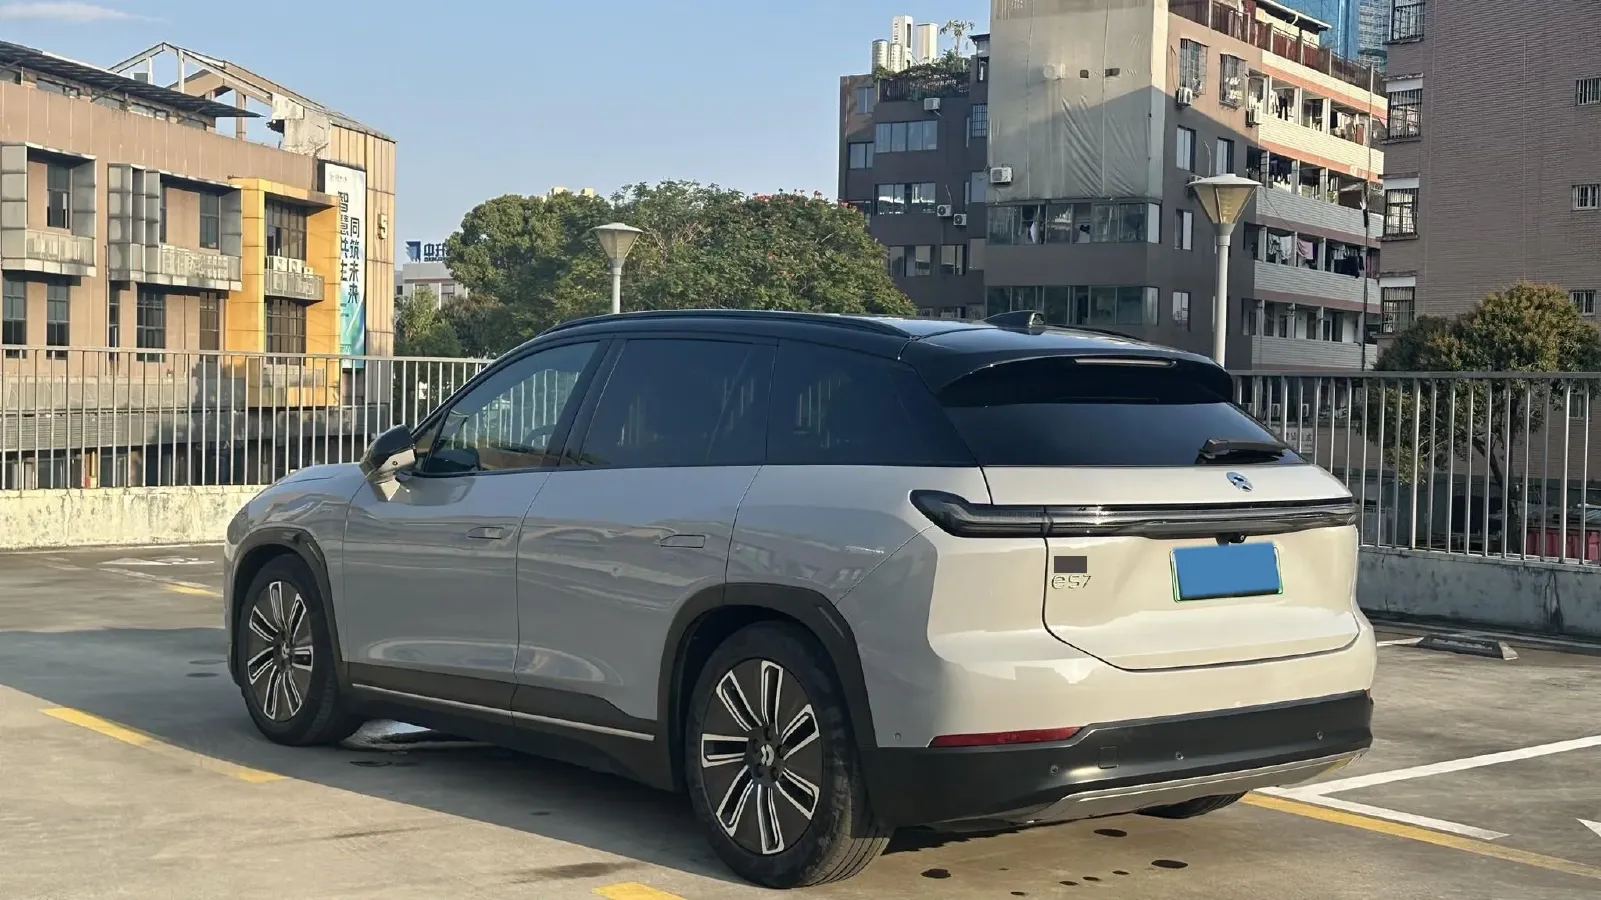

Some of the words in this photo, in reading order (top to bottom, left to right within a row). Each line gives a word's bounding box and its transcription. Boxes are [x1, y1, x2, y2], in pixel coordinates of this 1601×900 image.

[379, 214, 388, 240] 5
[348, 217, 360, 304] 同筑未来
